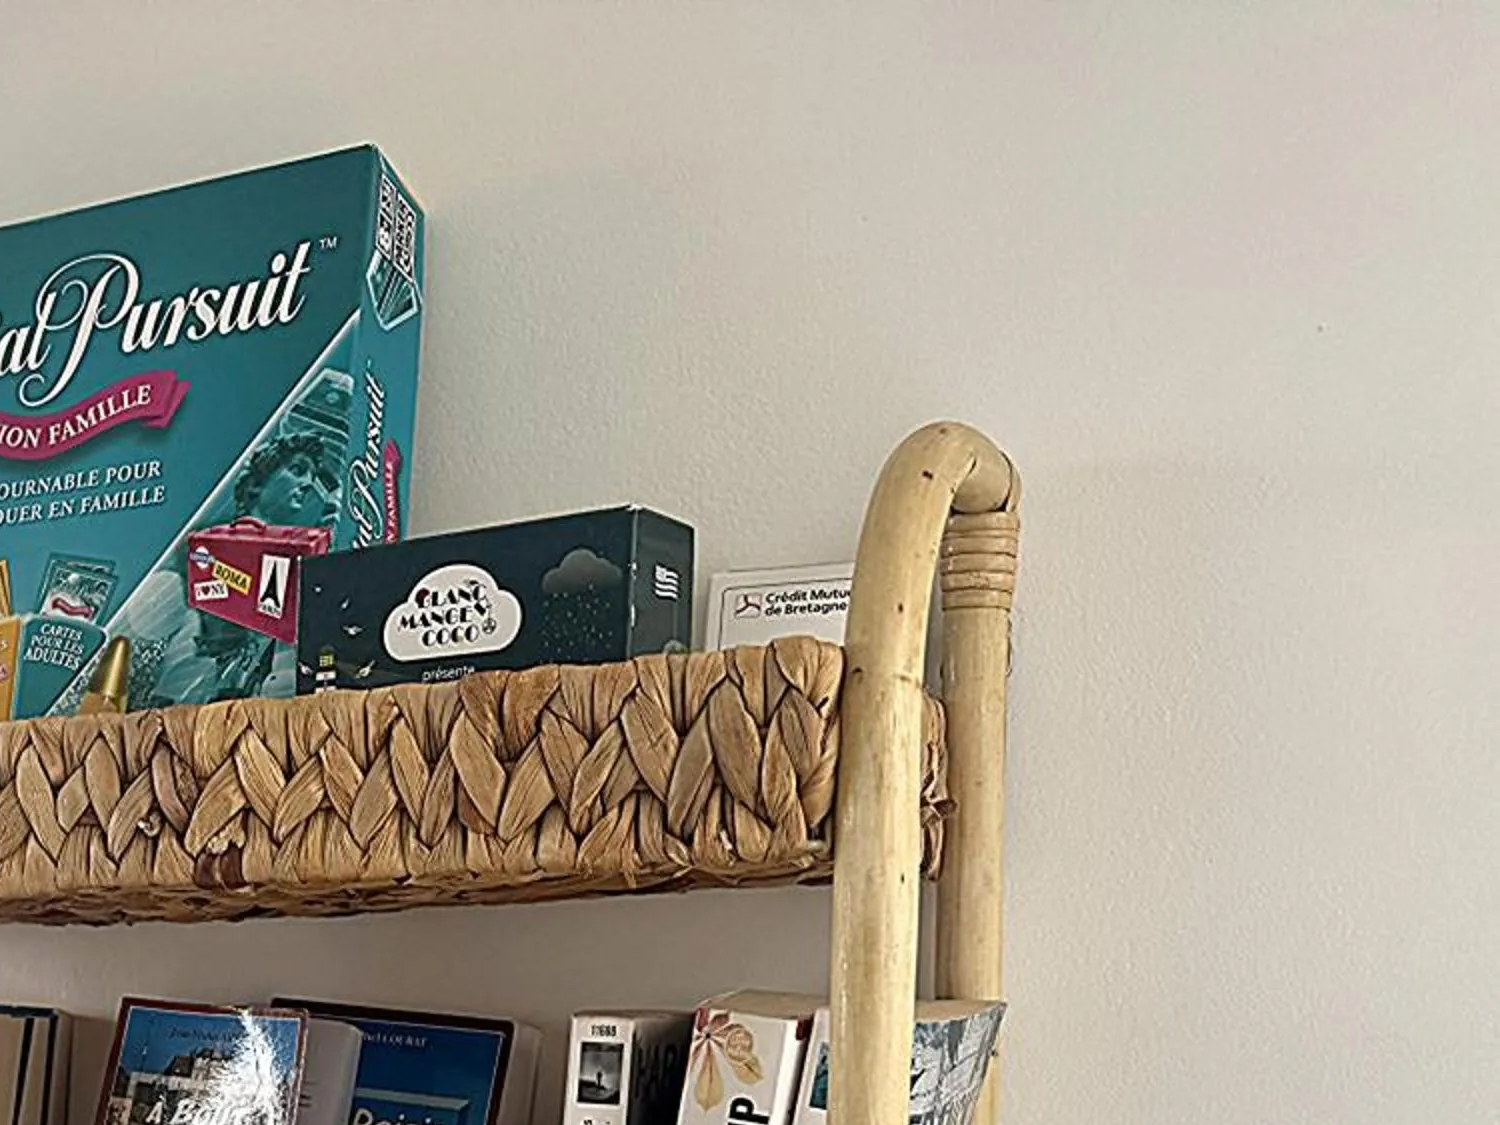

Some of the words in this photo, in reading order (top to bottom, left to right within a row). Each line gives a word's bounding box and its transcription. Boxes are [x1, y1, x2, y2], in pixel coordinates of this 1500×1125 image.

[19, 240, 312, 407] Pursuit
[49, 384, 152, 446] FAMILLE
[105, 461, 162, 485] POUR
[48, 501, 75, 517] EN
[79, 486, 165, 515] FAMILLE
[215, 564, 248, 589] ROMA
[765, 591, 807, 603] Crédit
[810, 588, 851, 601] Mutu
[765, 606, 782, 616] de
[784, 601, 847, 615] Bretagne
[40, 623, 83, 641] CARTES
[422, 624, 480, 647] COCO
[30, 635, 62, 650] POUR
[63, 640, 85, 655] LES
[24, 648, 84, 671] ADULTES
